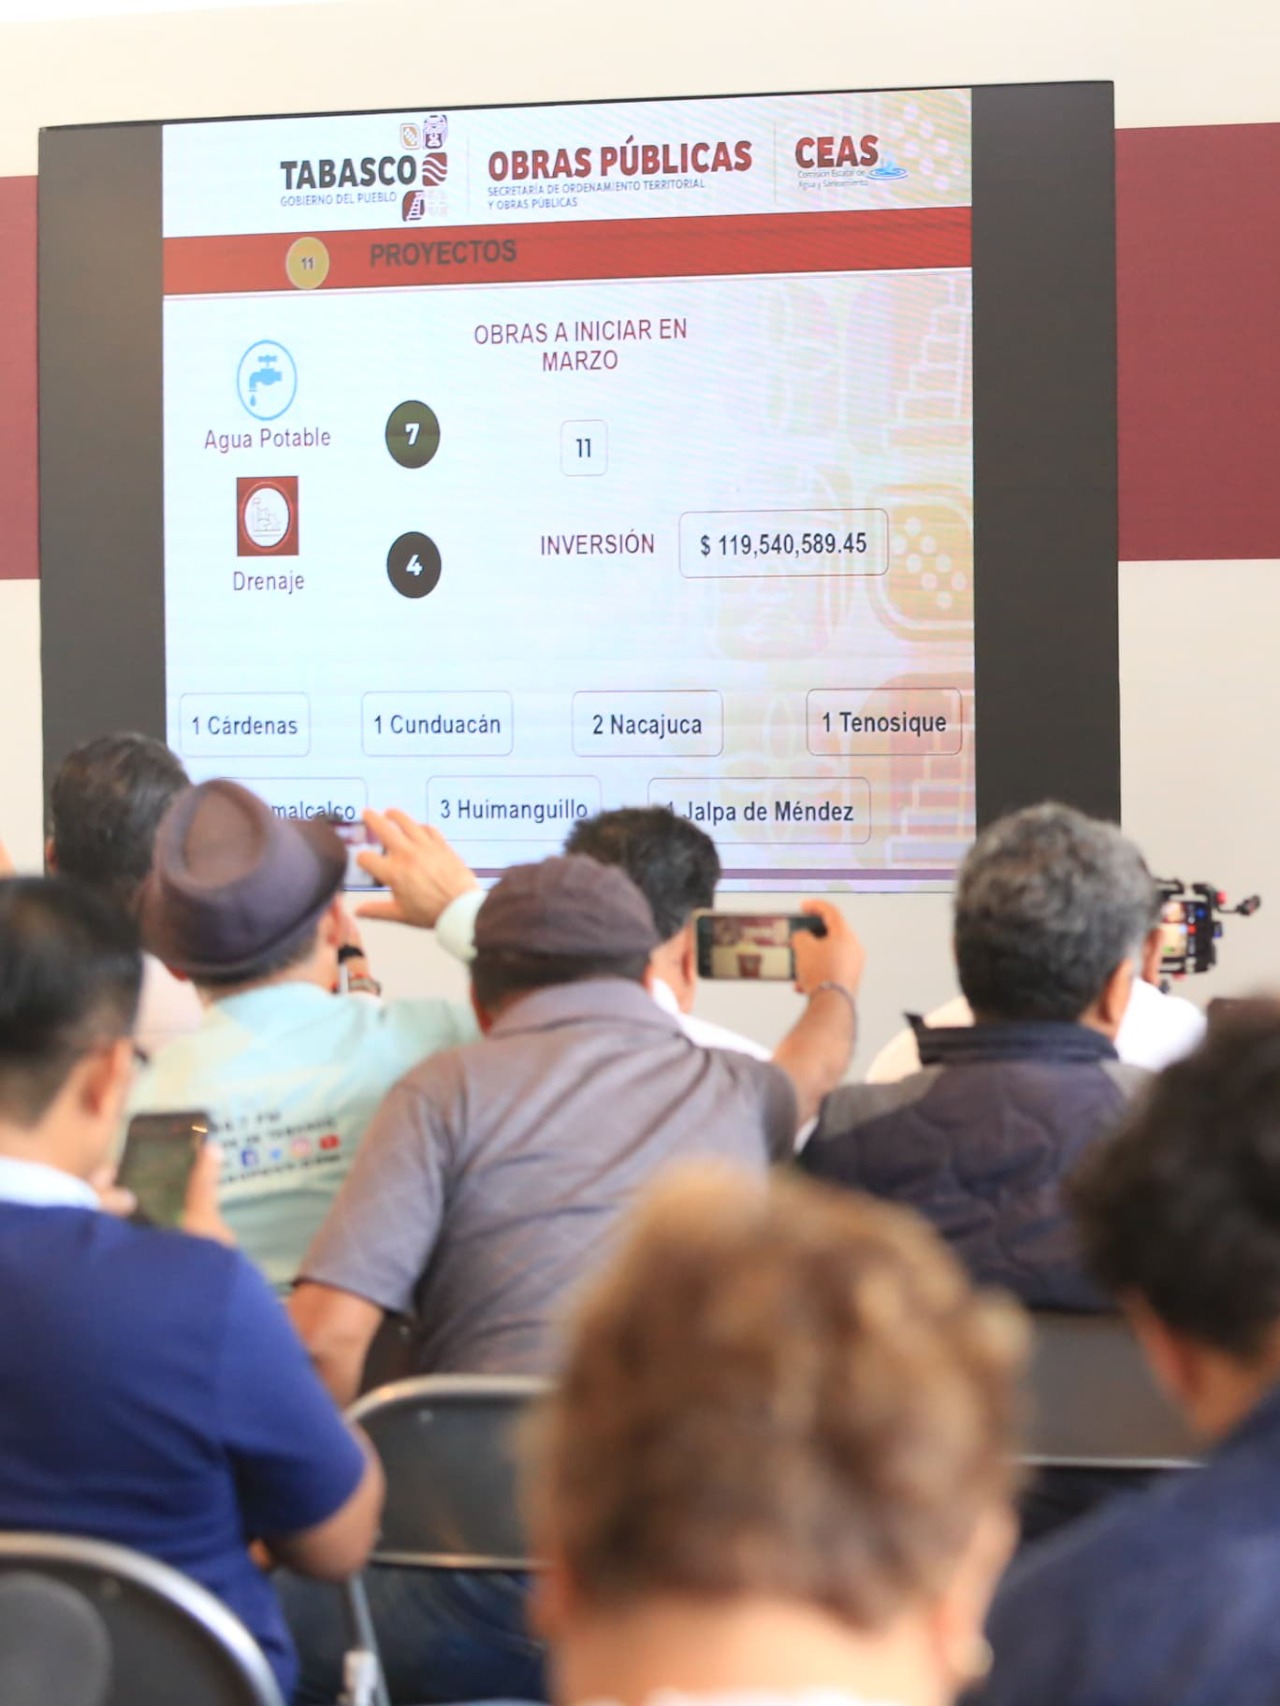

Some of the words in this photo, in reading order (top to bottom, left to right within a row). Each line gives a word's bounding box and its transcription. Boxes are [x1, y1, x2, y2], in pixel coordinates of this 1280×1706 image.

[488, 147, 592, 182] OBRAS
[600, 134, 753, 177] PÚBLICAS
[795, 134, 879, 169] CEAS
[280, 155, 417, 190] TABASCO
[280, 193, 333, 207] GOBIERNO
[336, 192, 355, 205] DEL
[357, 191, 397, 204] PUEBLO
[487, 183, 543, 197] SECRETARÍA
[547, 184, 560, 195] DE
[562, 180, 640, 194] ORDENAMIENTO
[643, 178, 705, 191] TERRITORIAL
[488, 201, 494, 210] Y
[497, 200, 529, 211] OBRAS
[531, 196, 578, 209] PÚBLICAS
[300, 256, 314, 270] 11
[369, 239, 517, 268] PROYECTOS
[474, 323, 548, 345] OBRAS
[554, 321, 568, 342] A
[574, 318, 653, 342] INICIAR
[659, 317, 688, 340] EN
[542, 349, 619, 372] MARZO
[204, 430, 253, 454] Agua
[260, 426, 331, 448] Potable
[405, 422, 420, 446] 7
[575, 438, 592, 459] 11
[540, 529, 656, 555] INVERSIÓN
[700, 535, 711, 558] $
[719, 532, 868, 559] 119,540,589.45
[405, 553, 423, 577] 4
[233, 570, 305, 595] Drenaje
[192, 716, 200, 735] 1
[207, 714, 298, 736] Cárdenas
[374, 716, 382, 734] 1
[390, 714, 501, 735] Cunduacán
[592, 714, 604, 735] 2
[610, 713, 703, 740] Nacajuca
[822, 712, 831, 733] 1
[839, 711, 947, 738] Tenosique
[271, 800, 356, 820] malcalco
[440, 799, 451, 819] 3
[458, 799, 588, 824] Huimanguillo
[683, 801, 736, 827] Jalpa
[744, 801, 768, 821] de
[775, 800, 855, 822] Méndez
